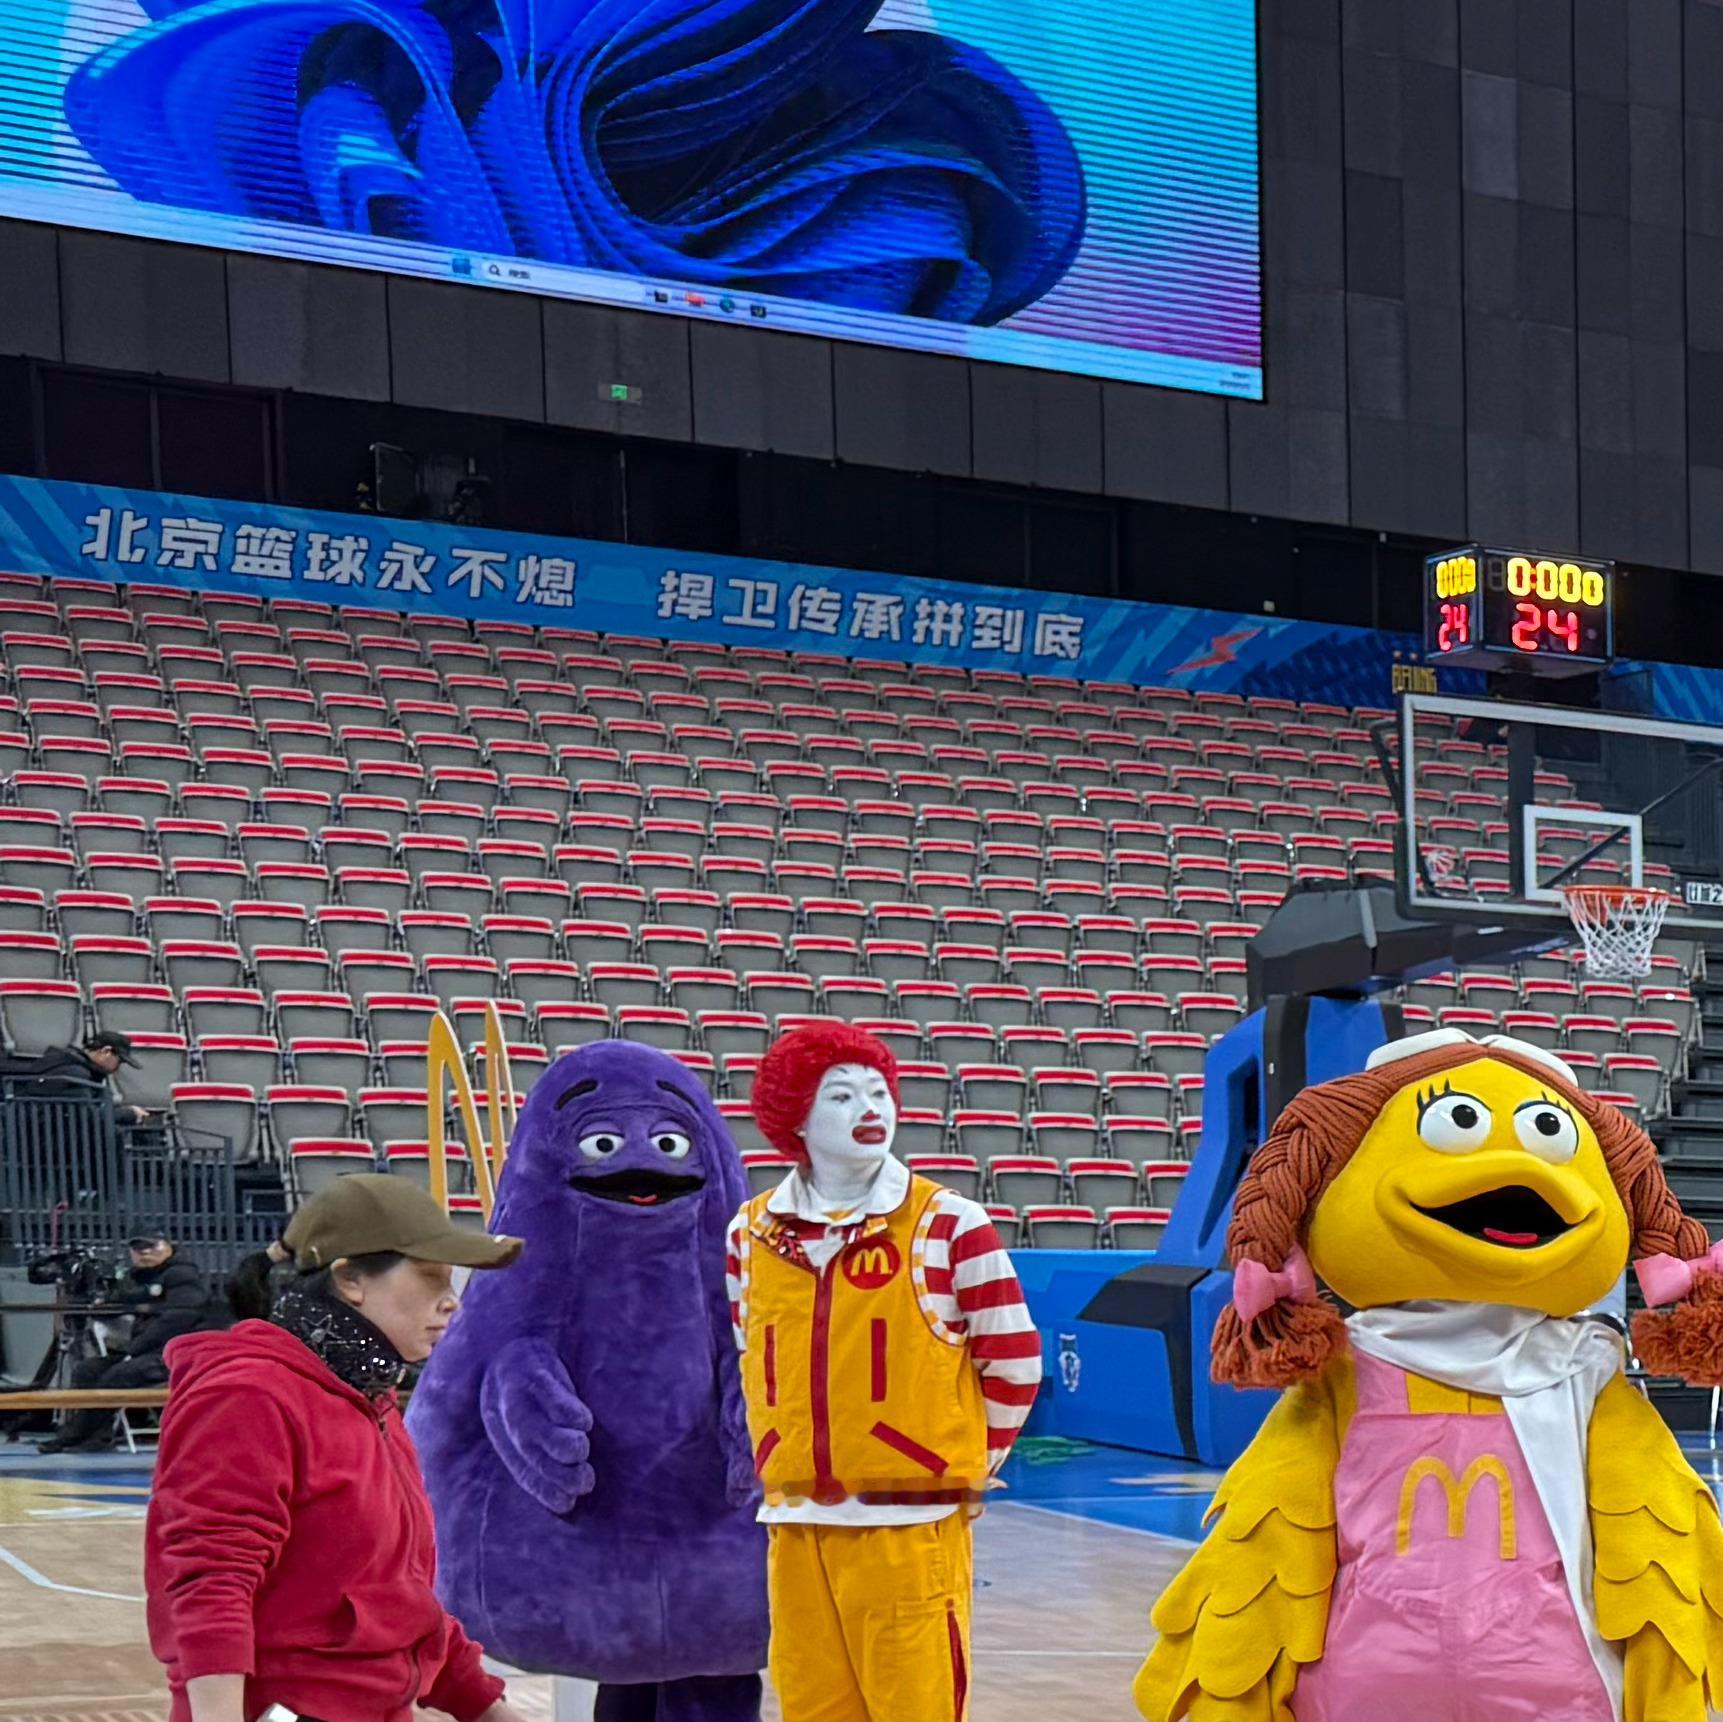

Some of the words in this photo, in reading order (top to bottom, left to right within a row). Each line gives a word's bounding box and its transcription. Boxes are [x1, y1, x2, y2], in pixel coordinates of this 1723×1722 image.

[80, 507, 577, 607] 北京篮球永不熄
[656, 569, 1085, 660] 捍卫传承拼到底
[1438, 603, 1470, 651] 24
[1512, 602, 1578, 651] 24
